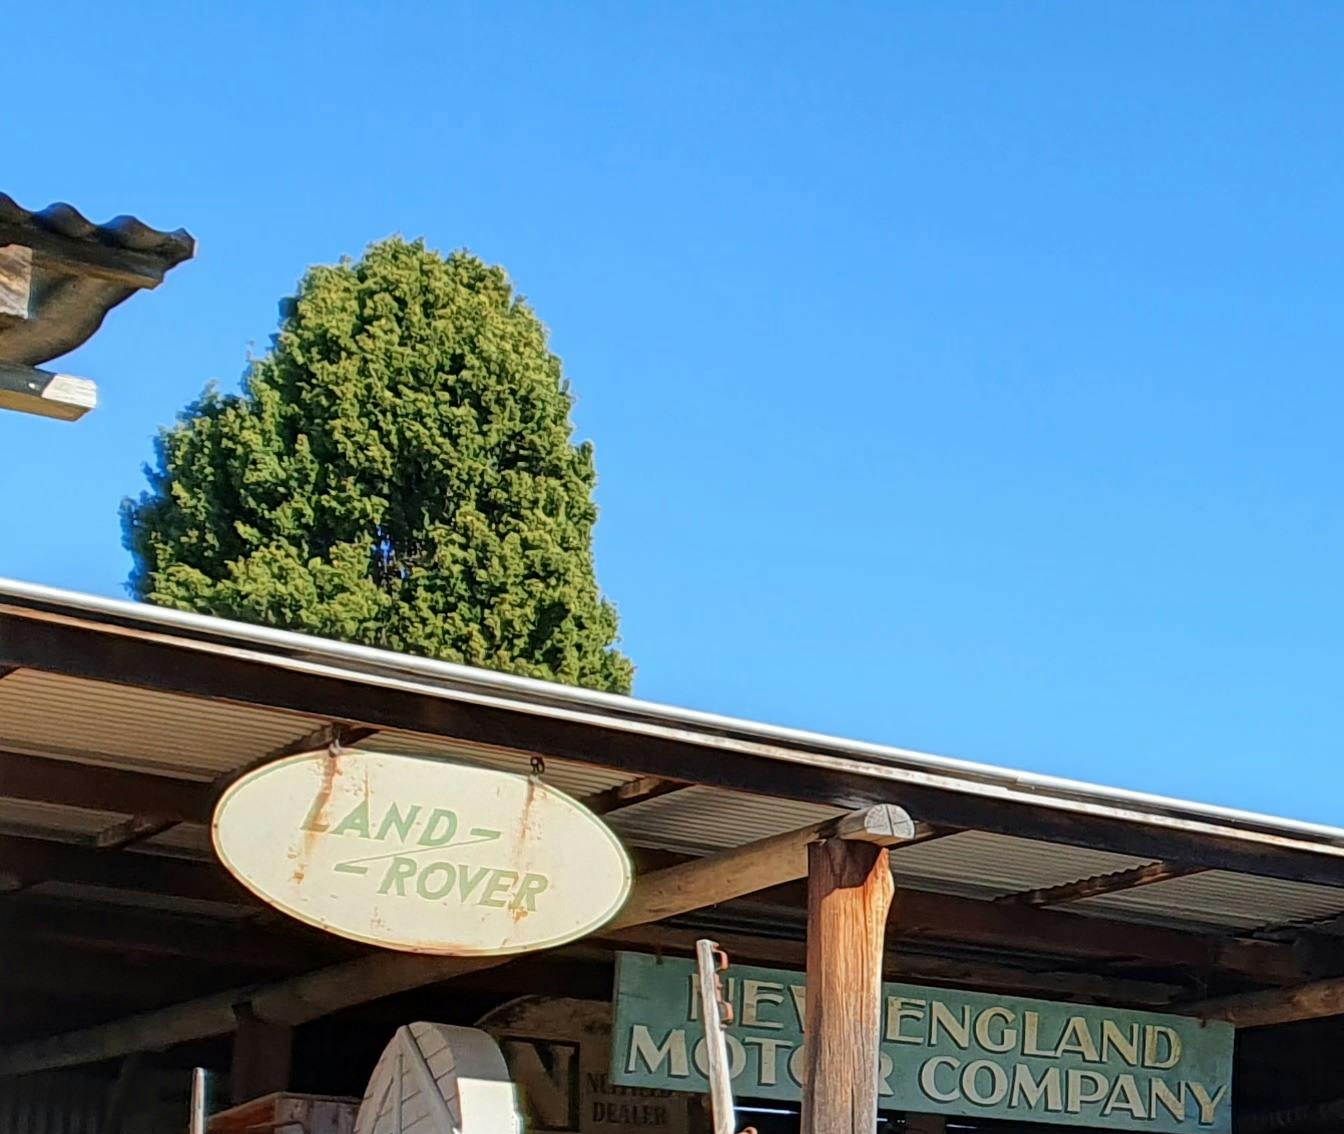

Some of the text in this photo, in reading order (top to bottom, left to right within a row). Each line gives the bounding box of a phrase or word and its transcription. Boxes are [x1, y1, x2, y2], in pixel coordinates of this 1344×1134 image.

[884, 996, 1183, 1070] ENGLAND
[592, 1102, 668, 1126] DEALER
[919, 1055, 1227, 1125] COMPANY
